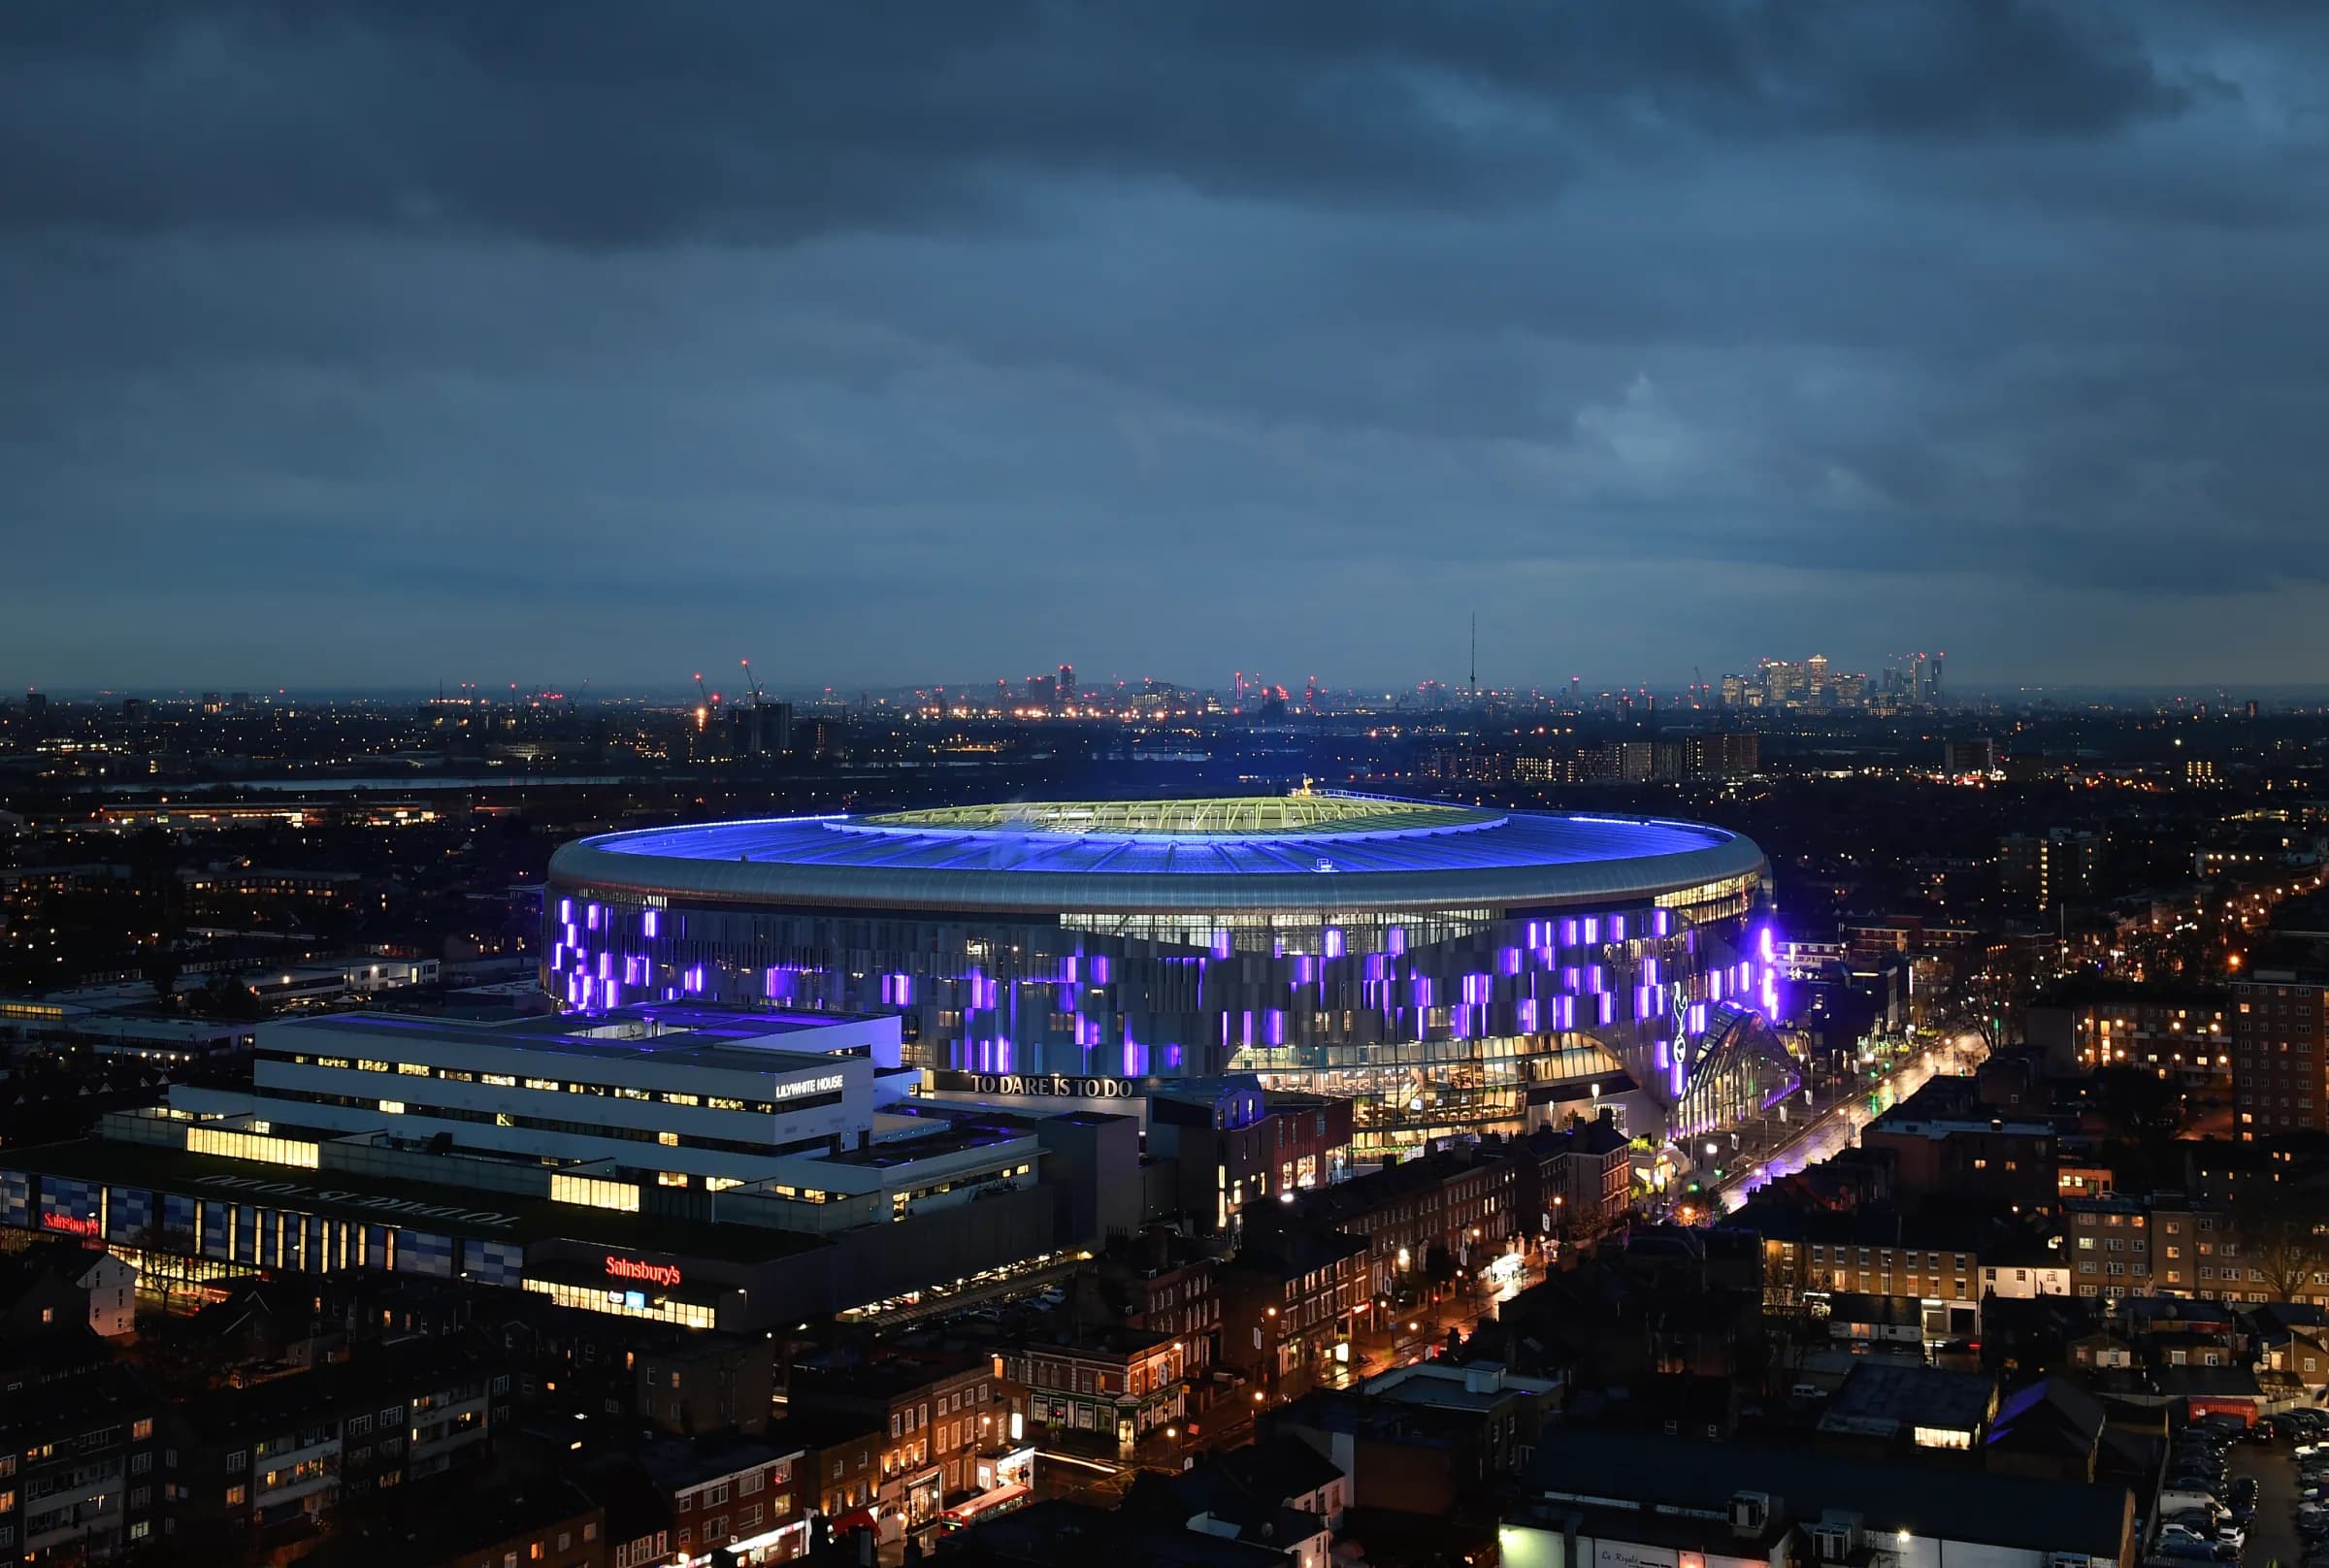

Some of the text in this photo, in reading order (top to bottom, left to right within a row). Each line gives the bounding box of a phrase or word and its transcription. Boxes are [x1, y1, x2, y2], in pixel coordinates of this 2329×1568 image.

[776, 1075, 843, 1097] LILYWHITE HOUSE
[971, 1075, 1132, 1097] TO DARE IS TO DO
[44, 1212, 100, 1236] Sainsbury's
[606, 1256, 681, 1287] Sainsbury's
